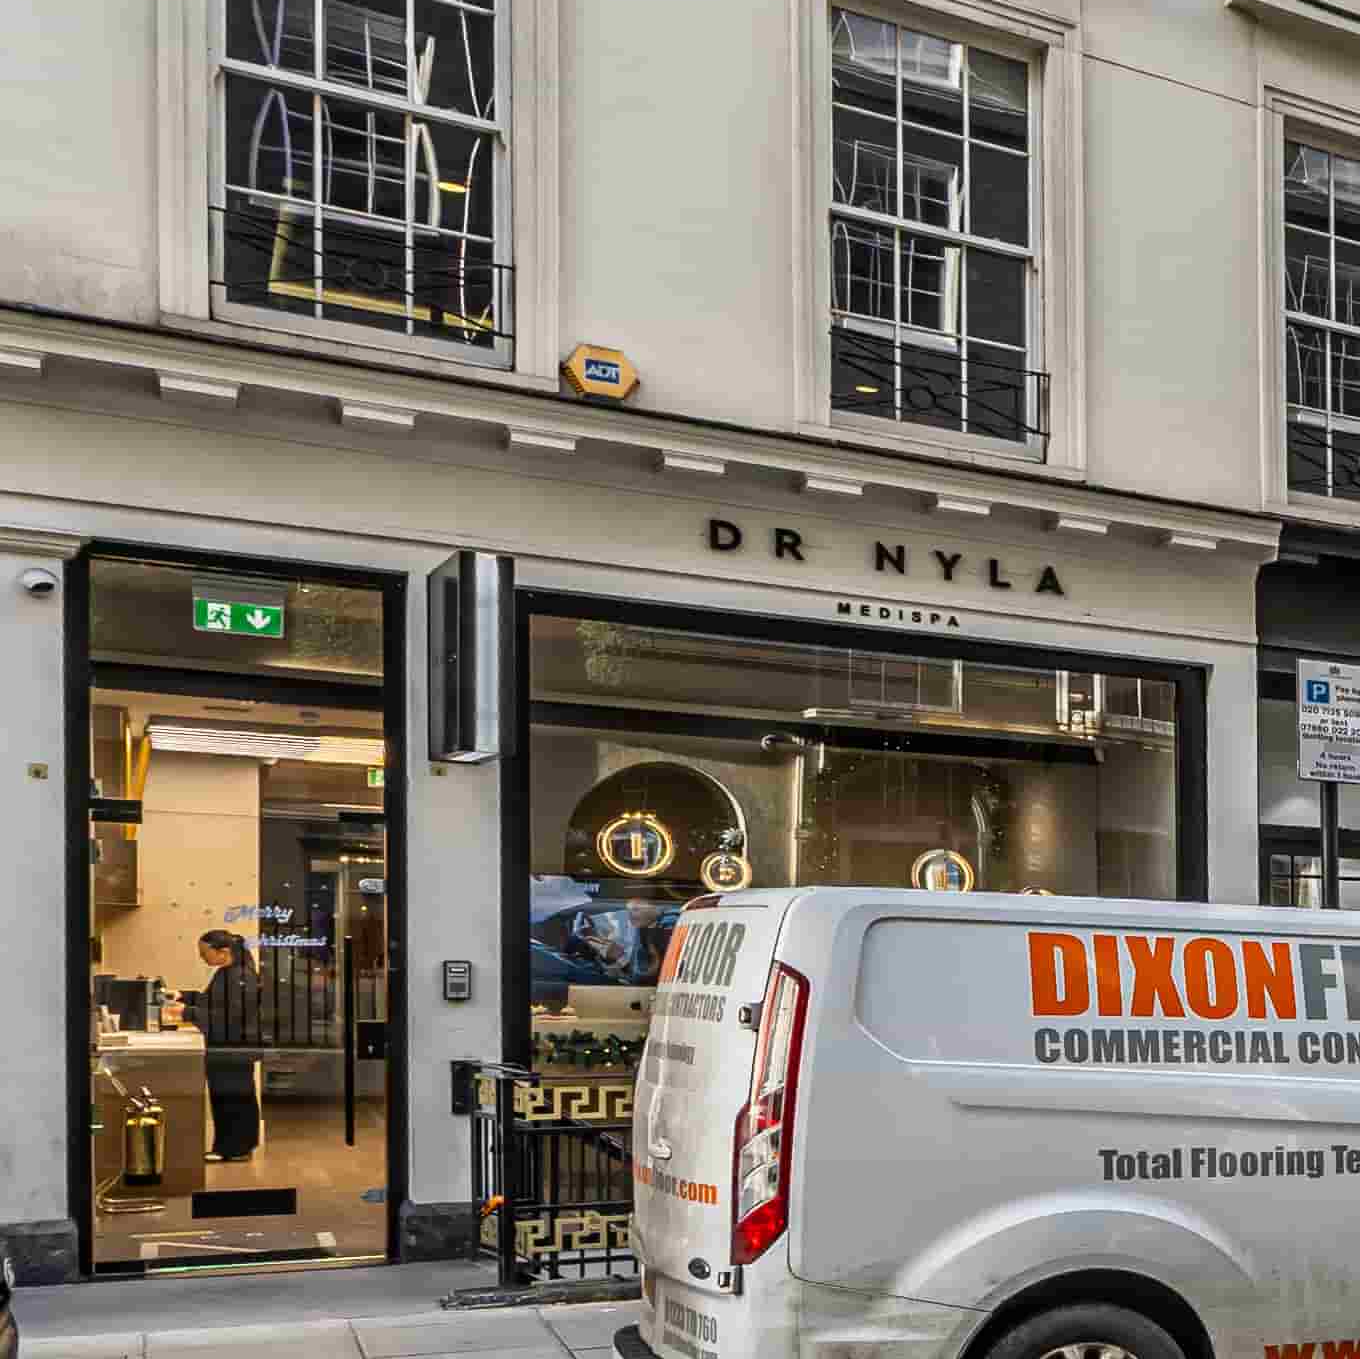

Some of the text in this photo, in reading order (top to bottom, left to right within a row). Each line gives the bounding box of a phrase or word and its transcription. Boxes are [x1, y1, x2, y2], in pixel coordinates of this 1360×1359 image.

[586, 363, 618, 382] ADT
[709, 519, 1065, 596] DR NYLA
[837, 601, 961, 628] MEDISPA
[1034, 1028, 1290, 1064] COMMERCIAL
[1098, 1147, 1183, 1181] Total
[1190, 1145, 1325, 1178] Flooring
